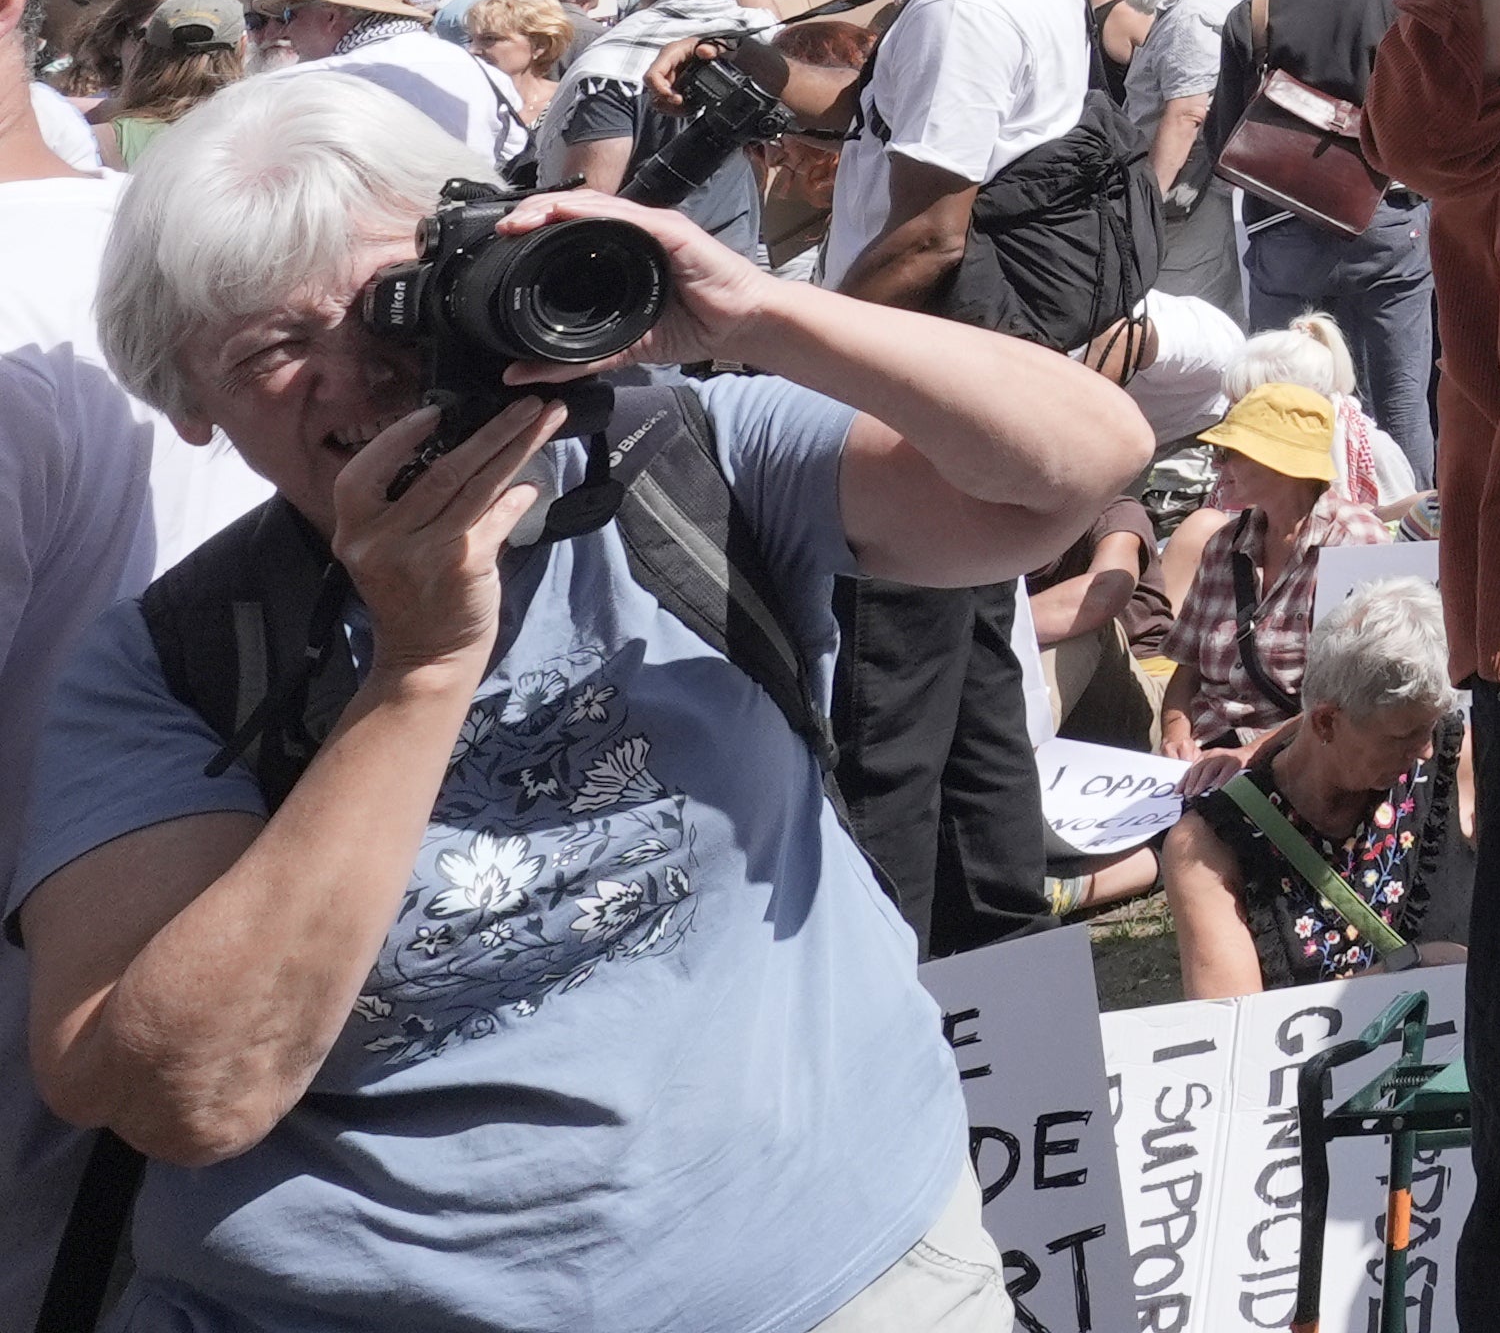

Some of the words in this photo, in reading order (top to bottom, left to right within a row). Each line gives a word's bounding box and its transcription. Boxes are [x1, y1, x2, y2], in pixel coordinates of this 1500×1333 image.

[390, 281, 406, 325] Nikon
[617, 410, 668, 452] Blacks
[1048, 765, 1068, 791] I
[1080, 774, 1184, 800] OPPO
